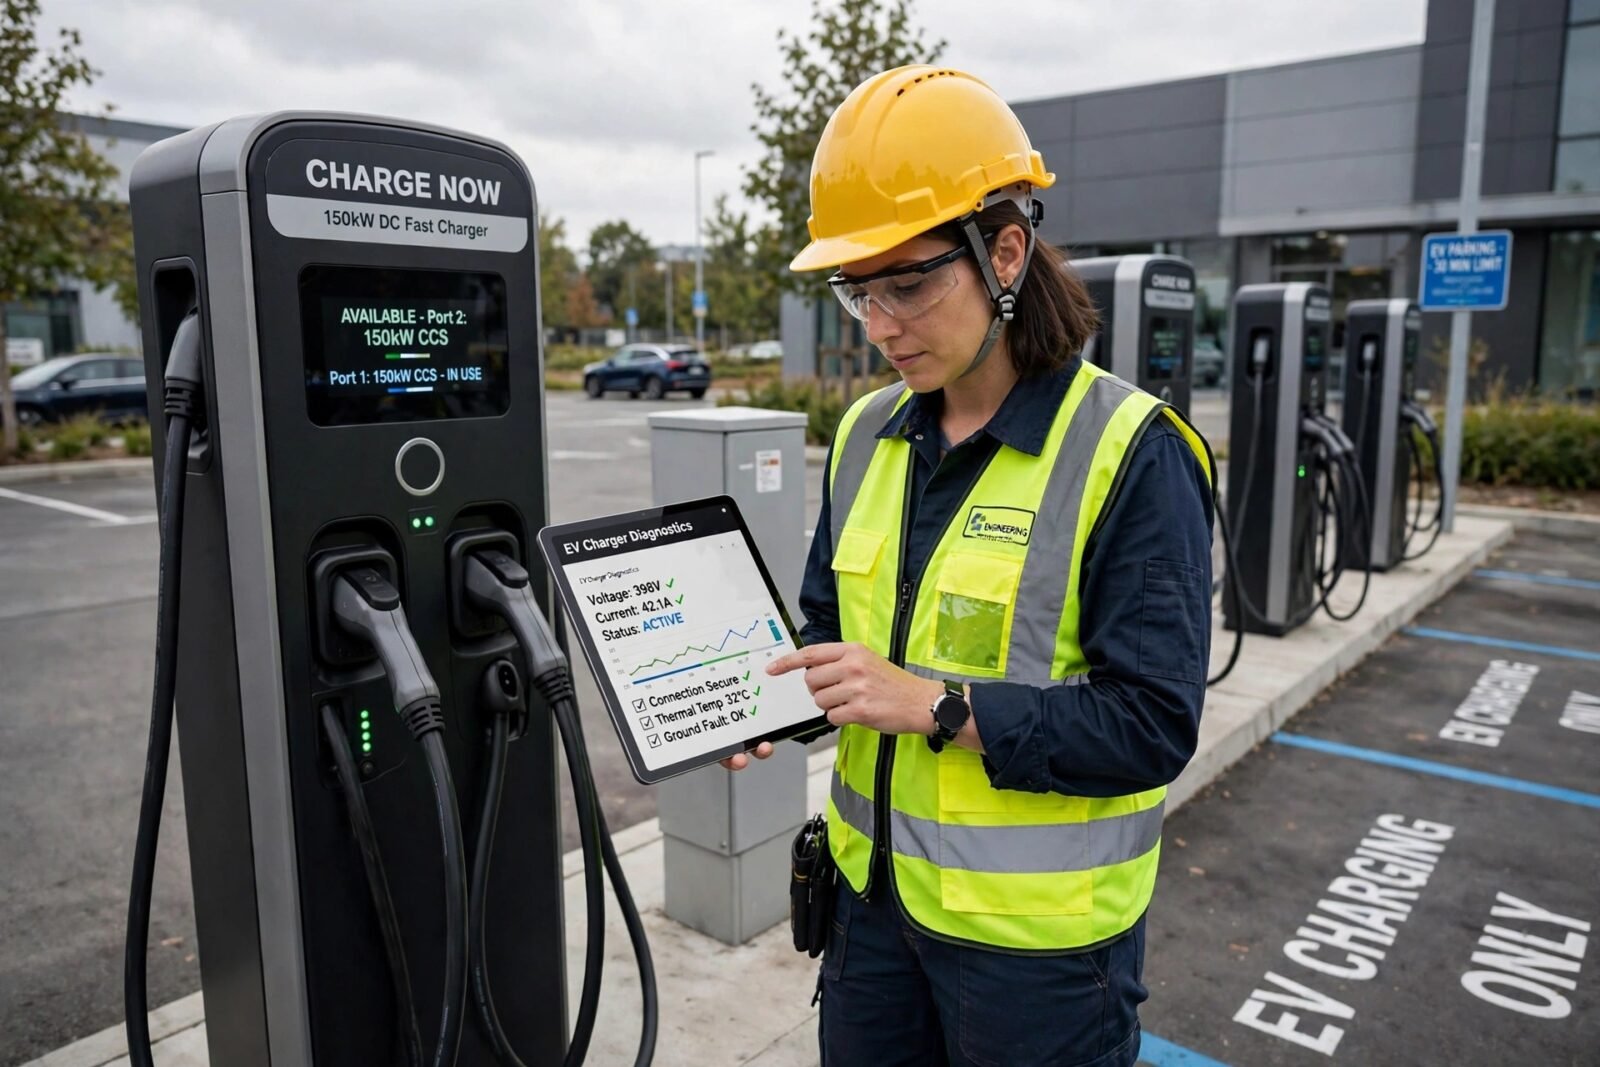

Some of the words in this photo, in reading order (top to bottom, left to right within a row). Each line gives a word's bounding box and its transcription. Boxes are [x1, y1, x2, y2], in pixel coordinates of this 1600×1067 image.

[306, 158, 432, 199] CHARGE
[439, 174, 501, 206] NOW
[324, 210, 375, 228] 150kW
[379, 214, 400, 230] DC
[405, 216, 434, 233] Fast
[437, 219, 489, 240] Charger
[341, 307, 416, 324] AVAILABLE
[427, 309, 454, 325] Port
[456, 310, 467, 325] 2:
[364, 329, 414, 346] 150kW
[418, 328, 449, 346] CCS
[330, 371, 357, 385] Port
[360, 370, 371, 384] 1:
[373, 369, 411, 383] 150kW
[414, 368, 437, 382] CCS
[447, 368, 459, 381] IN
[460, 367, 482, 381] USE
[563, 541, 580, 555] EV
[583, 534, 628, 552] Charger
[628, 521, 693, 542] Diagnostics
[587, 587, 633, 606] Voltage:
[633, 580, 661, 597] 398V
[595, 605, 640, 624] Current:
[642, 596, 673, 613] 42.1A
[602, 625, 641, 641] Status:
[642, 612, 684, 632] ACTIVE
[649, 685, 705, 708] Connection
[705, 675, 740, 692] Secure
[655, 705, 696, 726] Thermal
[696, 700, 724, 715] Temp
[727, 689, 751, 706] 32°C
[663, 723, 701, 743] Ground
[702, 715, 731, 732] Fault:
[730, 708, 748, 723] OK
[1282, 813, 1456, 982] CHARGING
[1459, 891, 1592, 1020] ONLY
[1232, 970, 1356, 1057] EV
